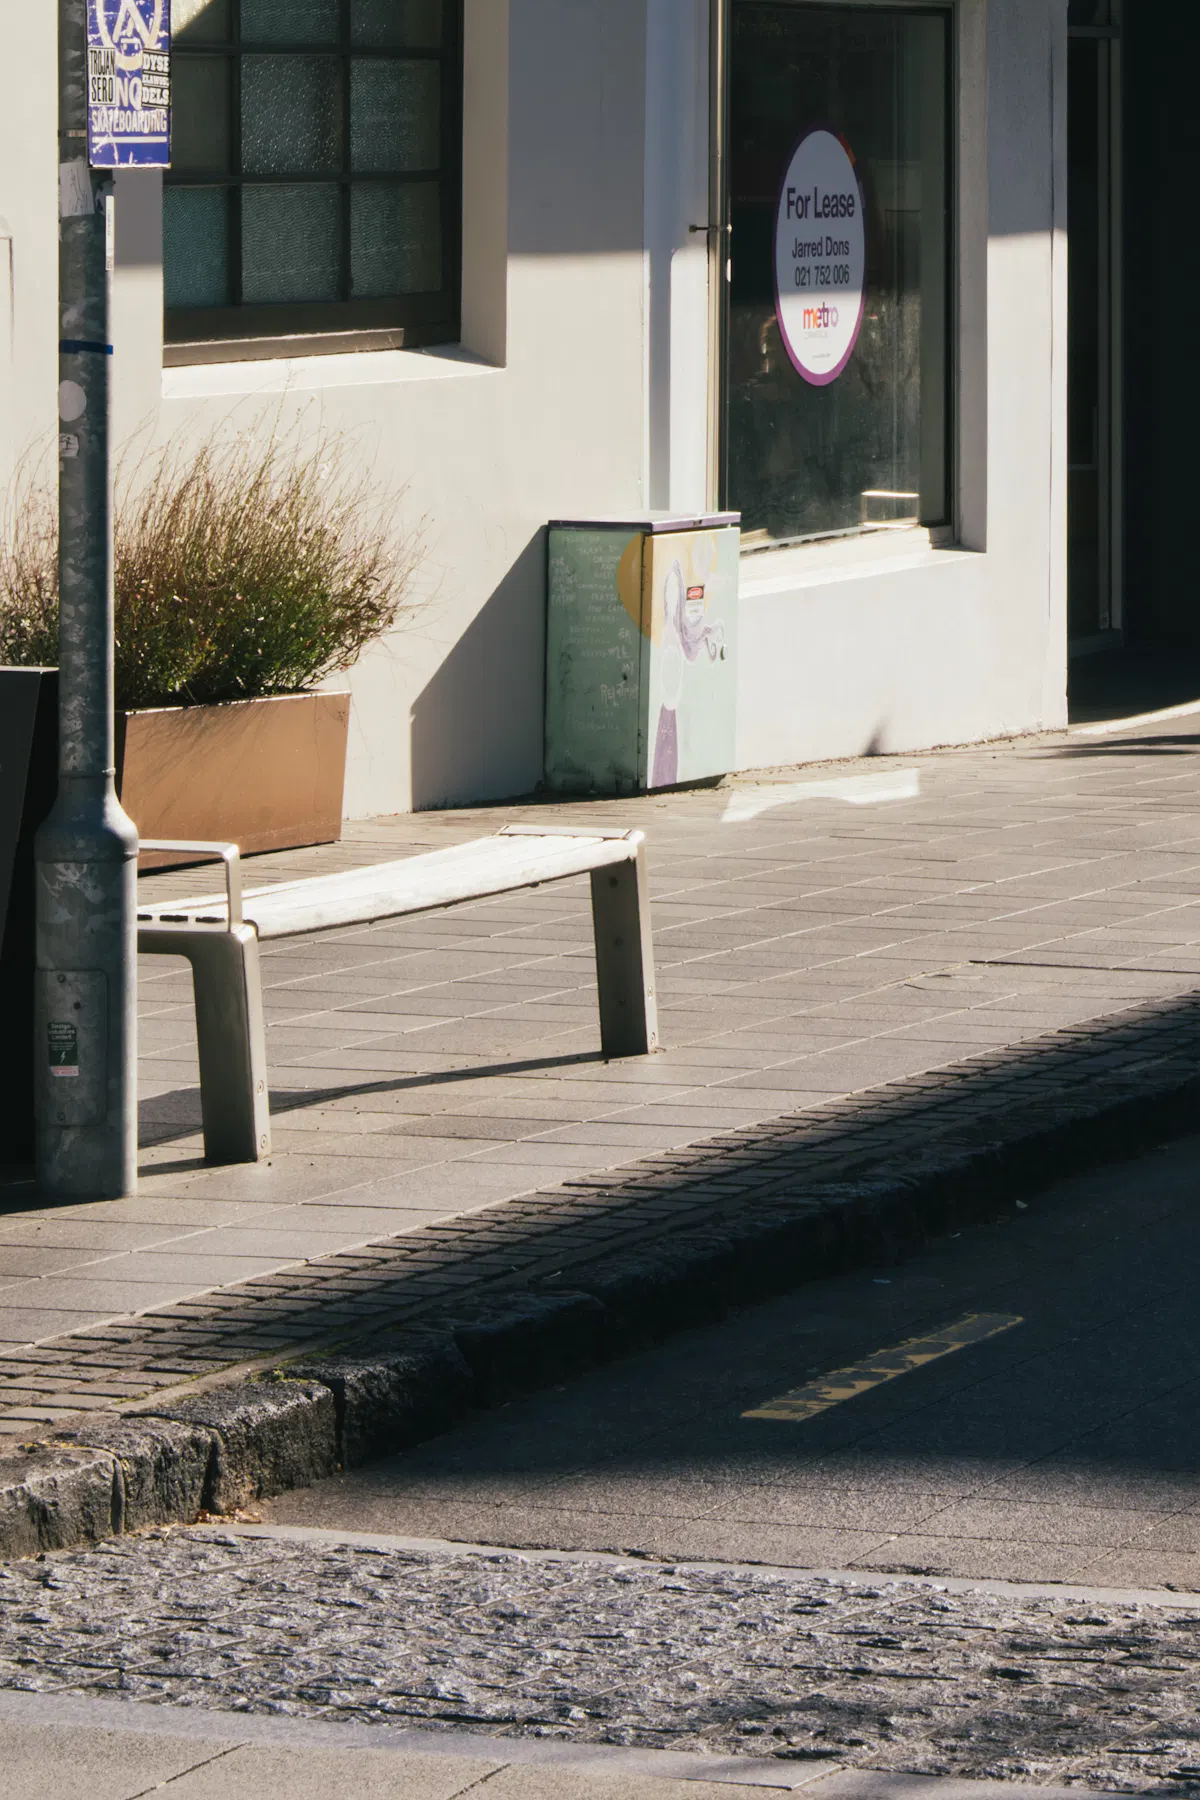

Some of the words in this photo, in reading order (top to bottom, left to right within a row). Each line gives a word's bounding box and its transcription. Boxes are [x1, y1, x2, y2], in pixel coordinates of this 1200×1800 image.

[90, 49, 115, 76] TROJAN
[91, 76, 114, 103] SERO
[116, 76, 143, 110] NO
[142, 87, 170, 105] DELS
[91, 108, 168, 133] SKATEBOARDING
[786, 187, 811, 220] For
[814, 186, 855, 219] Lease
[792, 236, 823, 259] Jarred
[826, 236, 850, 257] Dons
[794, 266, 811, 287] 021
[814, 265, 831, 287] 752
[833, 263, 850, 286] 006
[803, 302, 839, 330] metro
